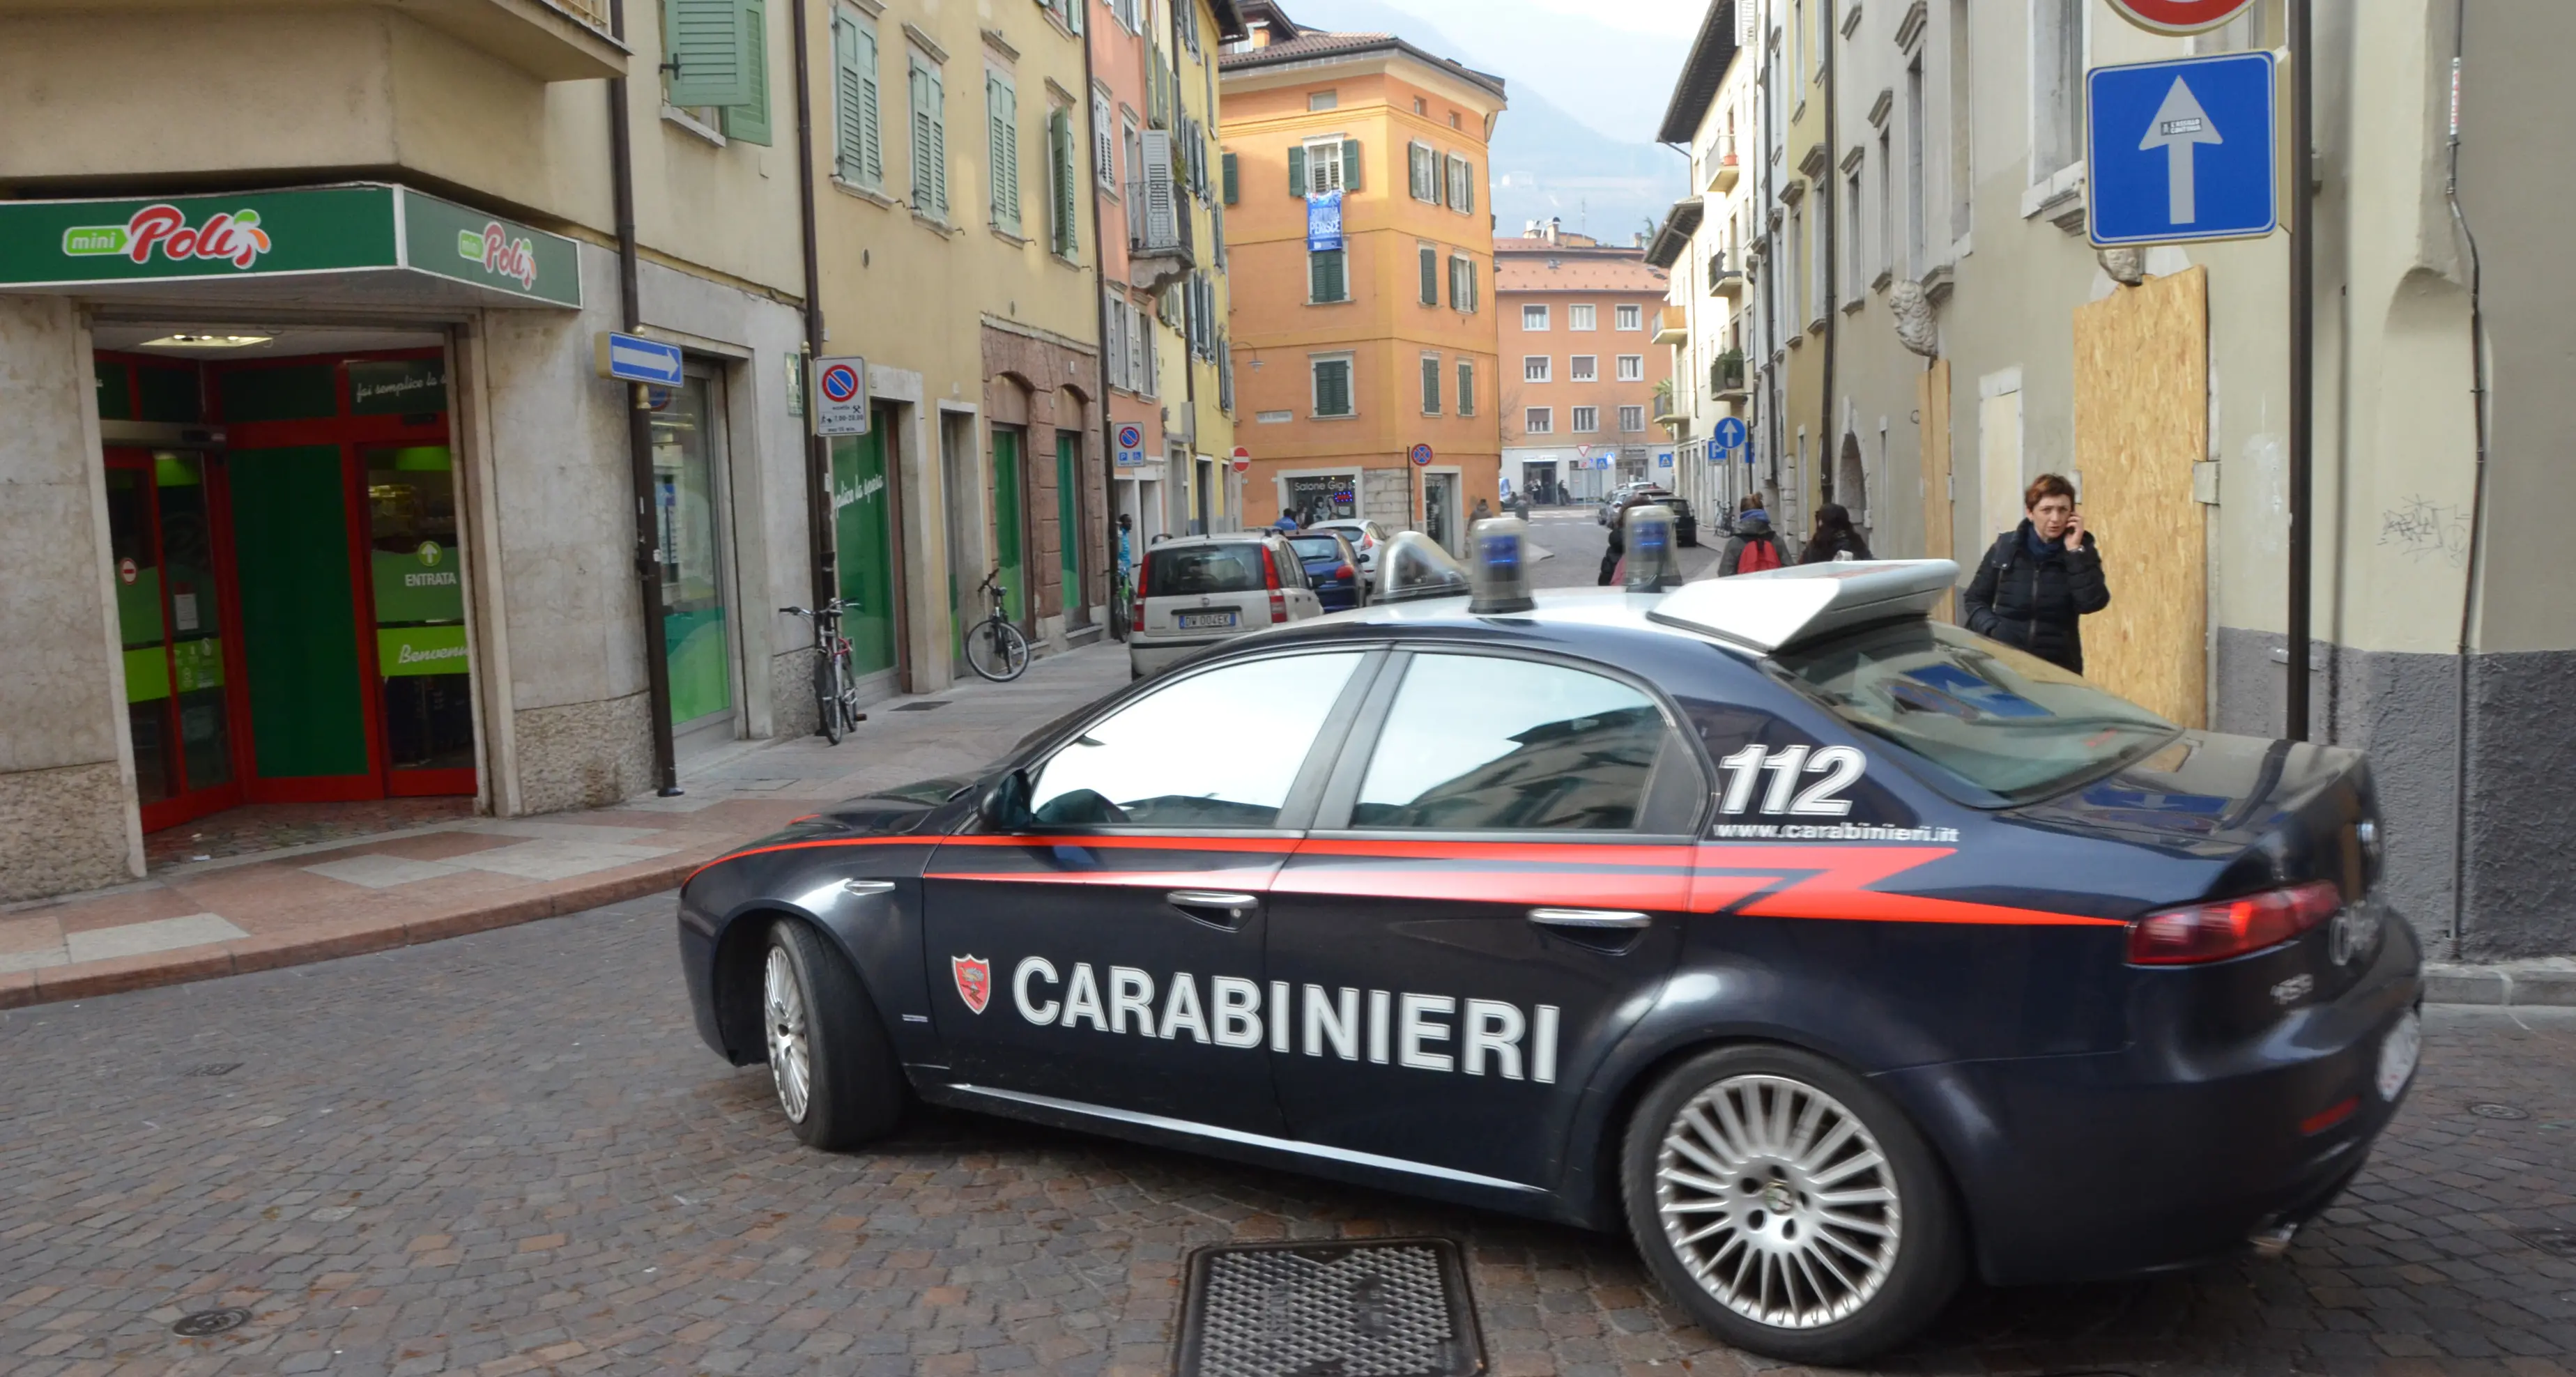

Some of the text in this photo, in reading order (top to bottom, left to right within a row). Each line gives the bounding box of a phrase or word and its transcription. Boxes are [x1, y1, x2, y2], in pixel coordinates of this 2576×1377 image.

[71, 206, 238, 262] mini Poli
[485, 224, 525, 276] Poli
[1712, 441, 1723, 458] P
[1294, 482, 1325, 491] Salone
[404, 571, 457, 587] ENTRATA
[1719, 744, 1866, 815] 112
[1712, 822, 1961, 843] www.carabinieri.it
[1013, 955, 1561, 1084] CARABINIERI
